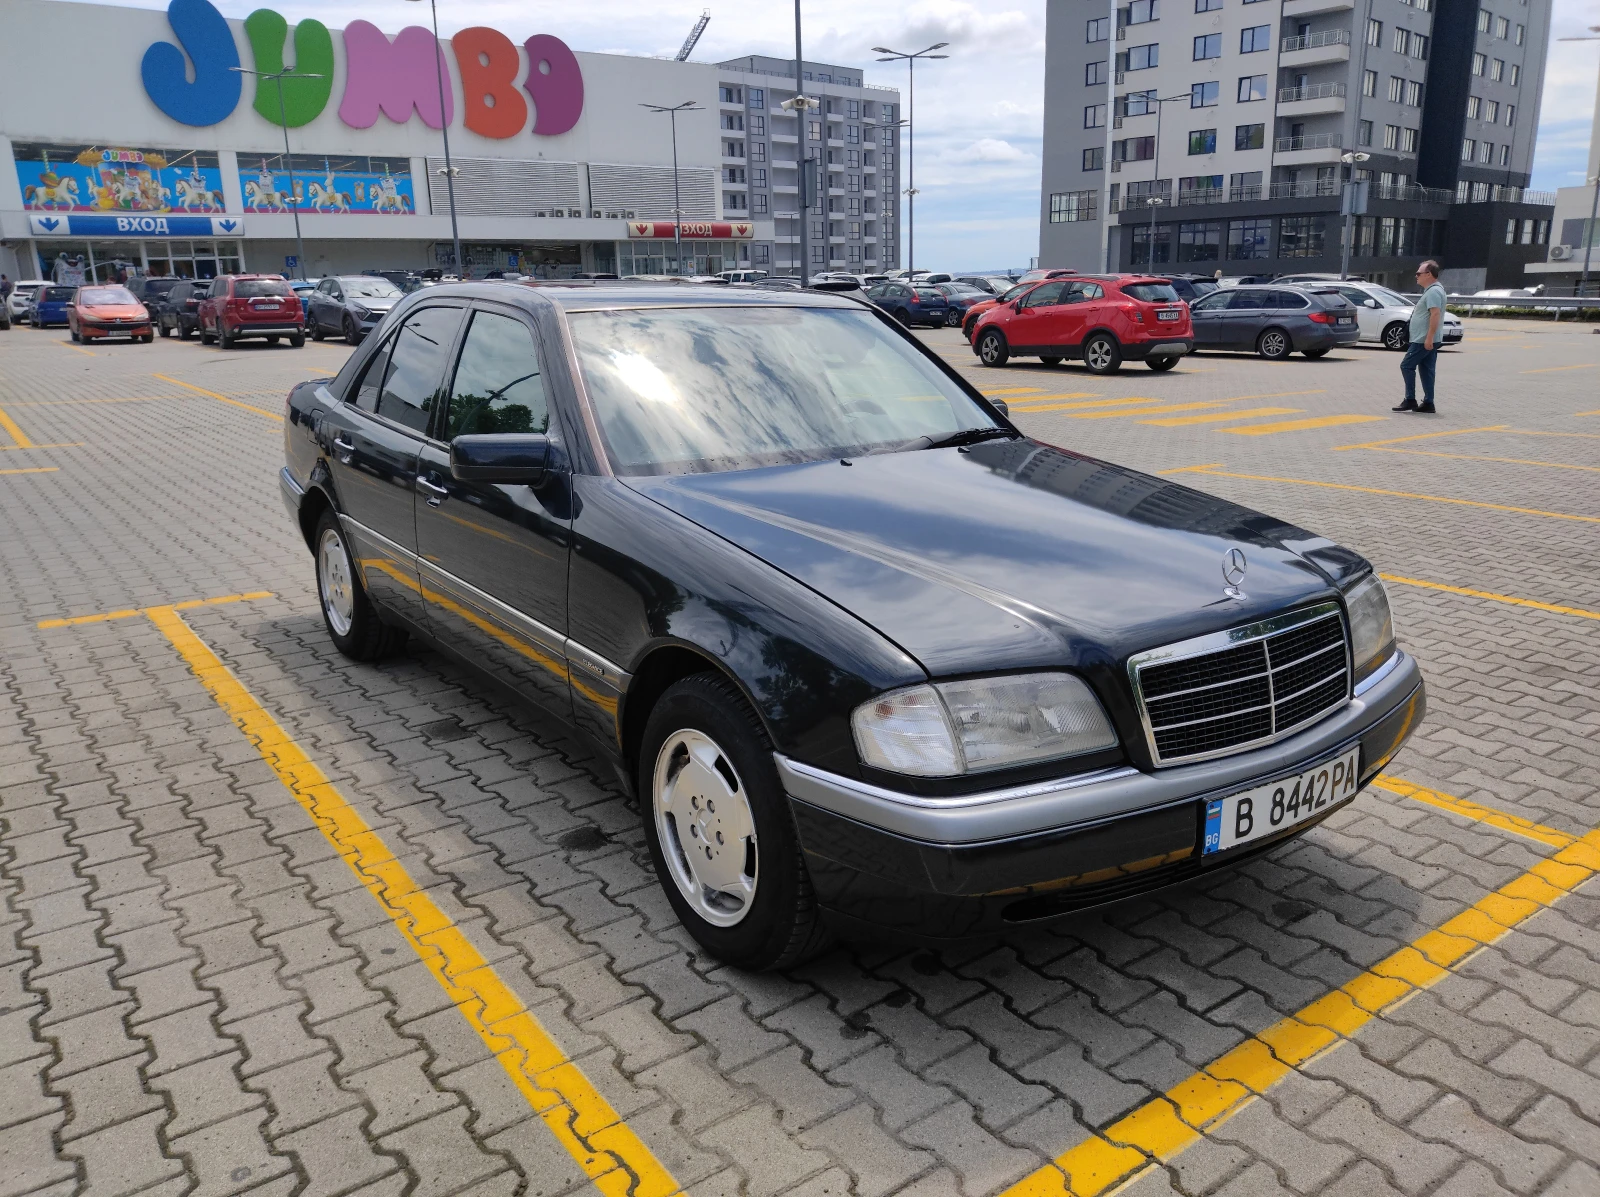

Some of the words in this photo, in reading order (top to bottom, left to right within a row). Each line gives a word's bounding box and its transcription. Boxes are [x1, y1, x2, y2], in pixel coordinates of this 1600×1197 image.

[141, 0, 584, 139] JUMBO
[102, 149, 144, 163] JUMBO
[116, 217, 170, 235] ВХОД
[1235, 797, 1253, 839] B
[1205, 832, 1219, 847] BG
